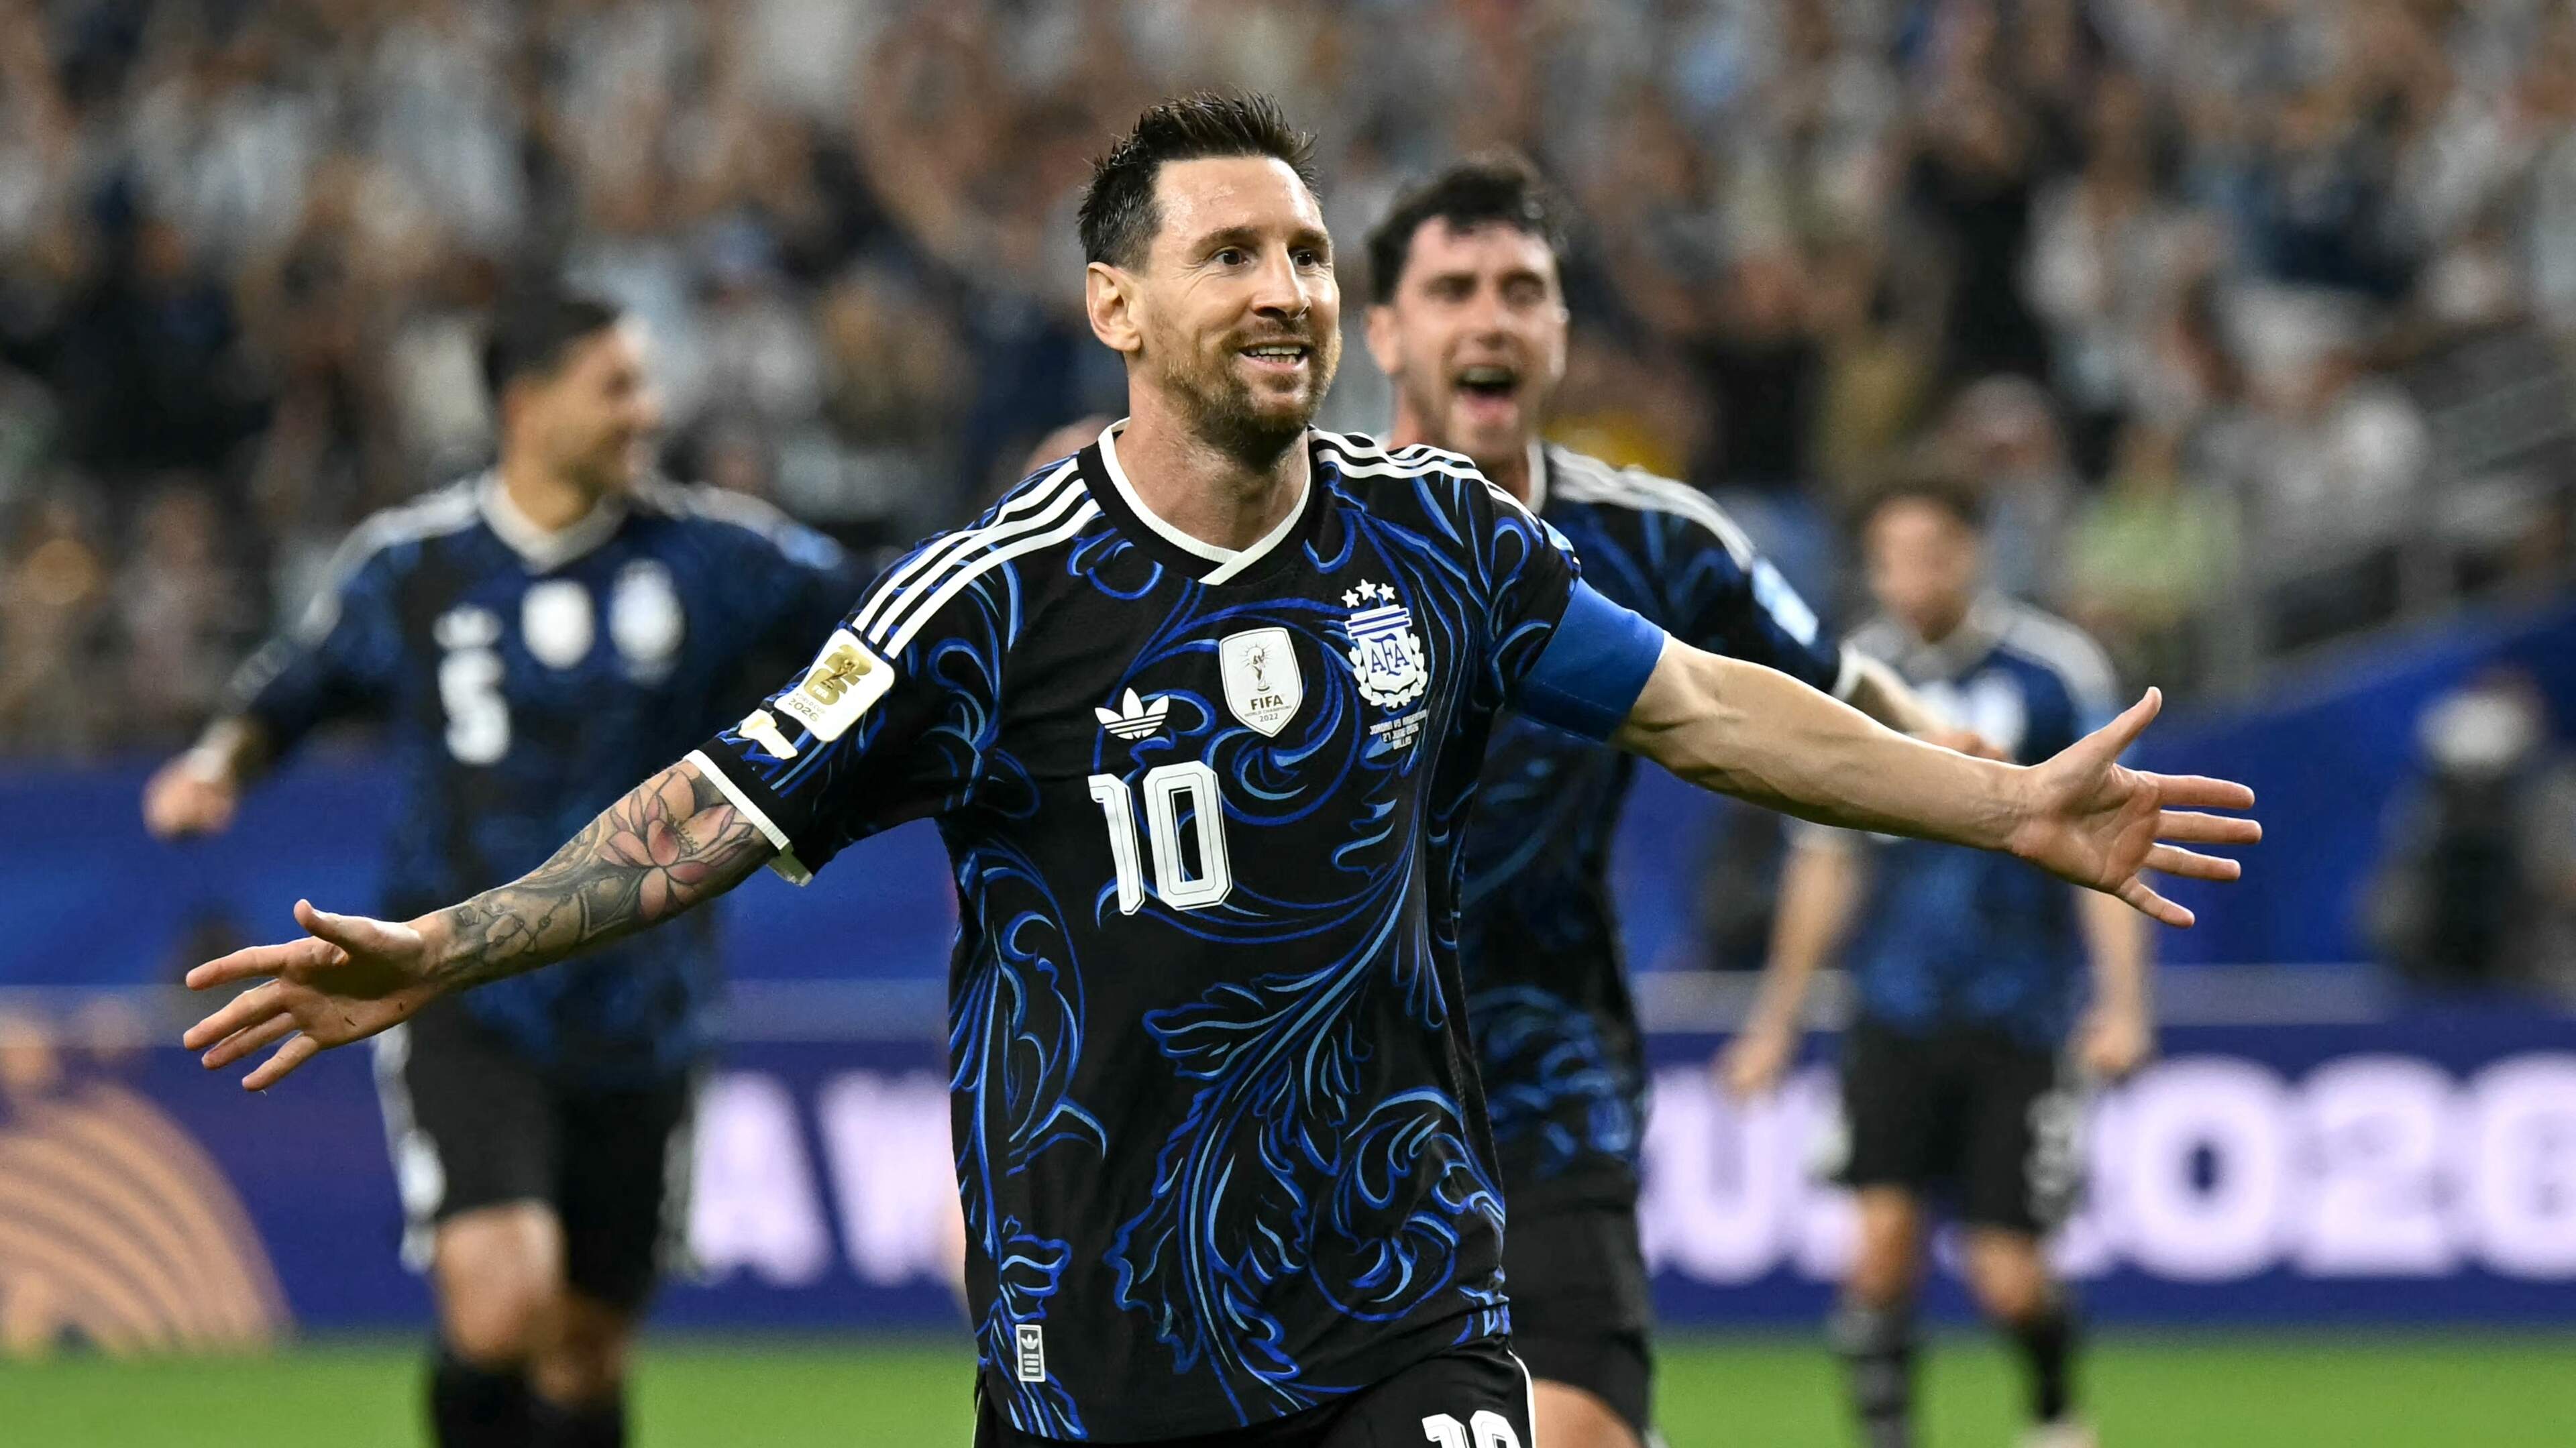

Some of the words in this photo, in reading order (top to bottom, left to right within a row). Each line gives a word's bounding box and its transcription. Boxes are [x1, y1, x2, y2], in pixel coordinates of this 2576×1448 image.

[1368, 633, 1410, 676] AFA
[438, 645, 511, 764] 5
[788, 698, 819, 722] 2026
[1250, 695, 1283, 710] FIFA
[1260, 713, 1279, 722] 2022
[1382, 732, 1391, 742] 27
[1088, 760, 1233, 915] 10
[1979, 1053, 2576, 1282] 026
